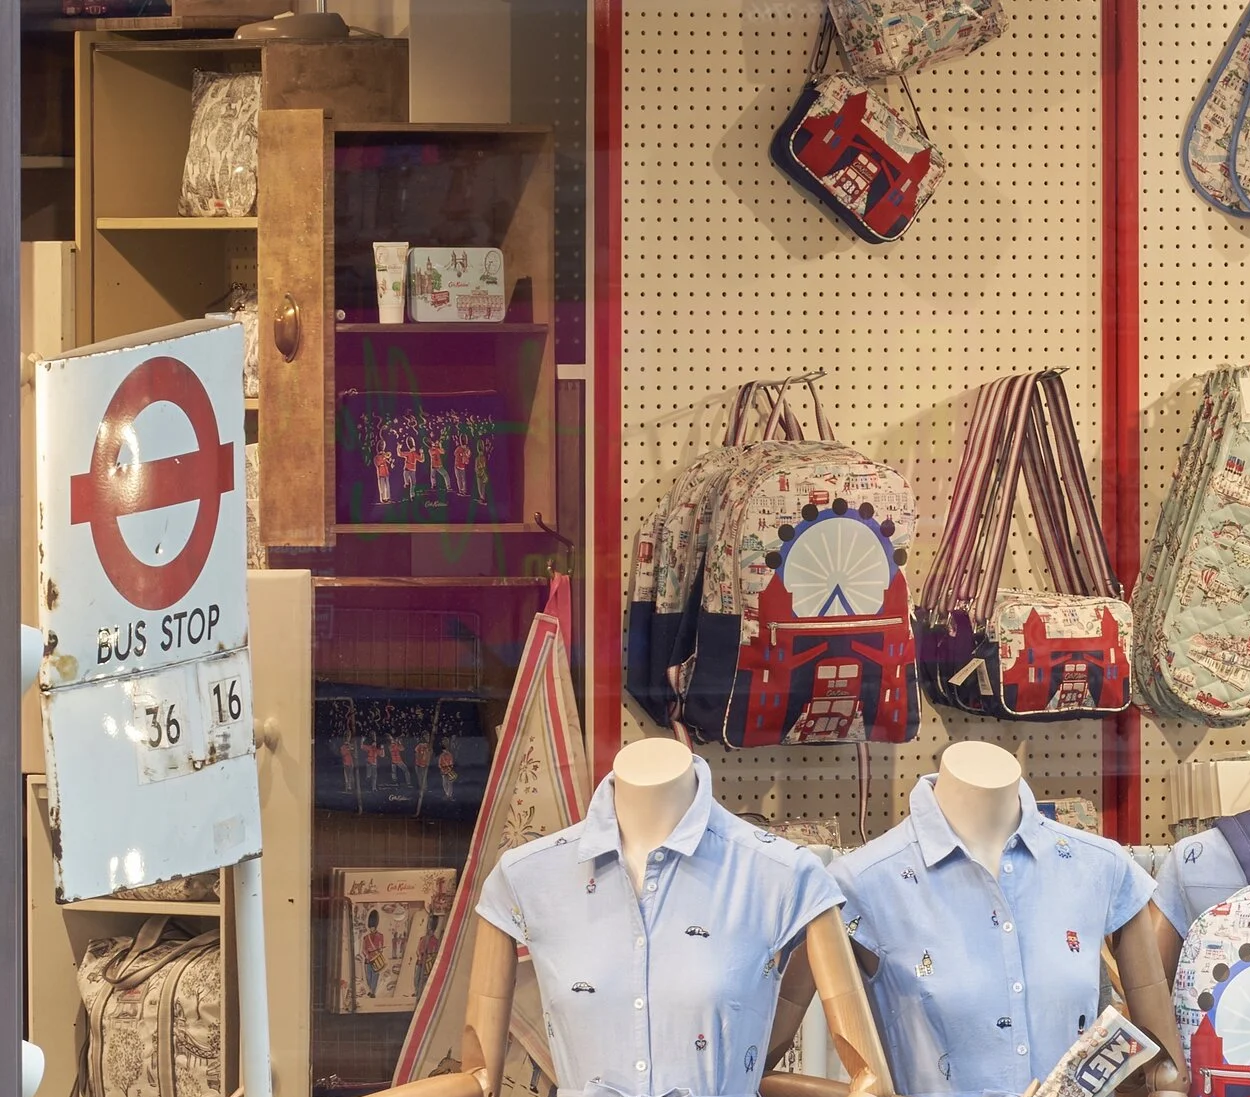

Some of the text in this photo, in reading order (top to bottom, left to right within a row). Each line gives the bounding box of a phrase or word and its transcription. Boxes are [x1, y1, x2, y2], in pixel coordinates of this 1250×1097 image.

[97, 604, 220, 664] BUS STOP
[213, 680, 241, 723] 16
[144, 704, 181, 748] 36
